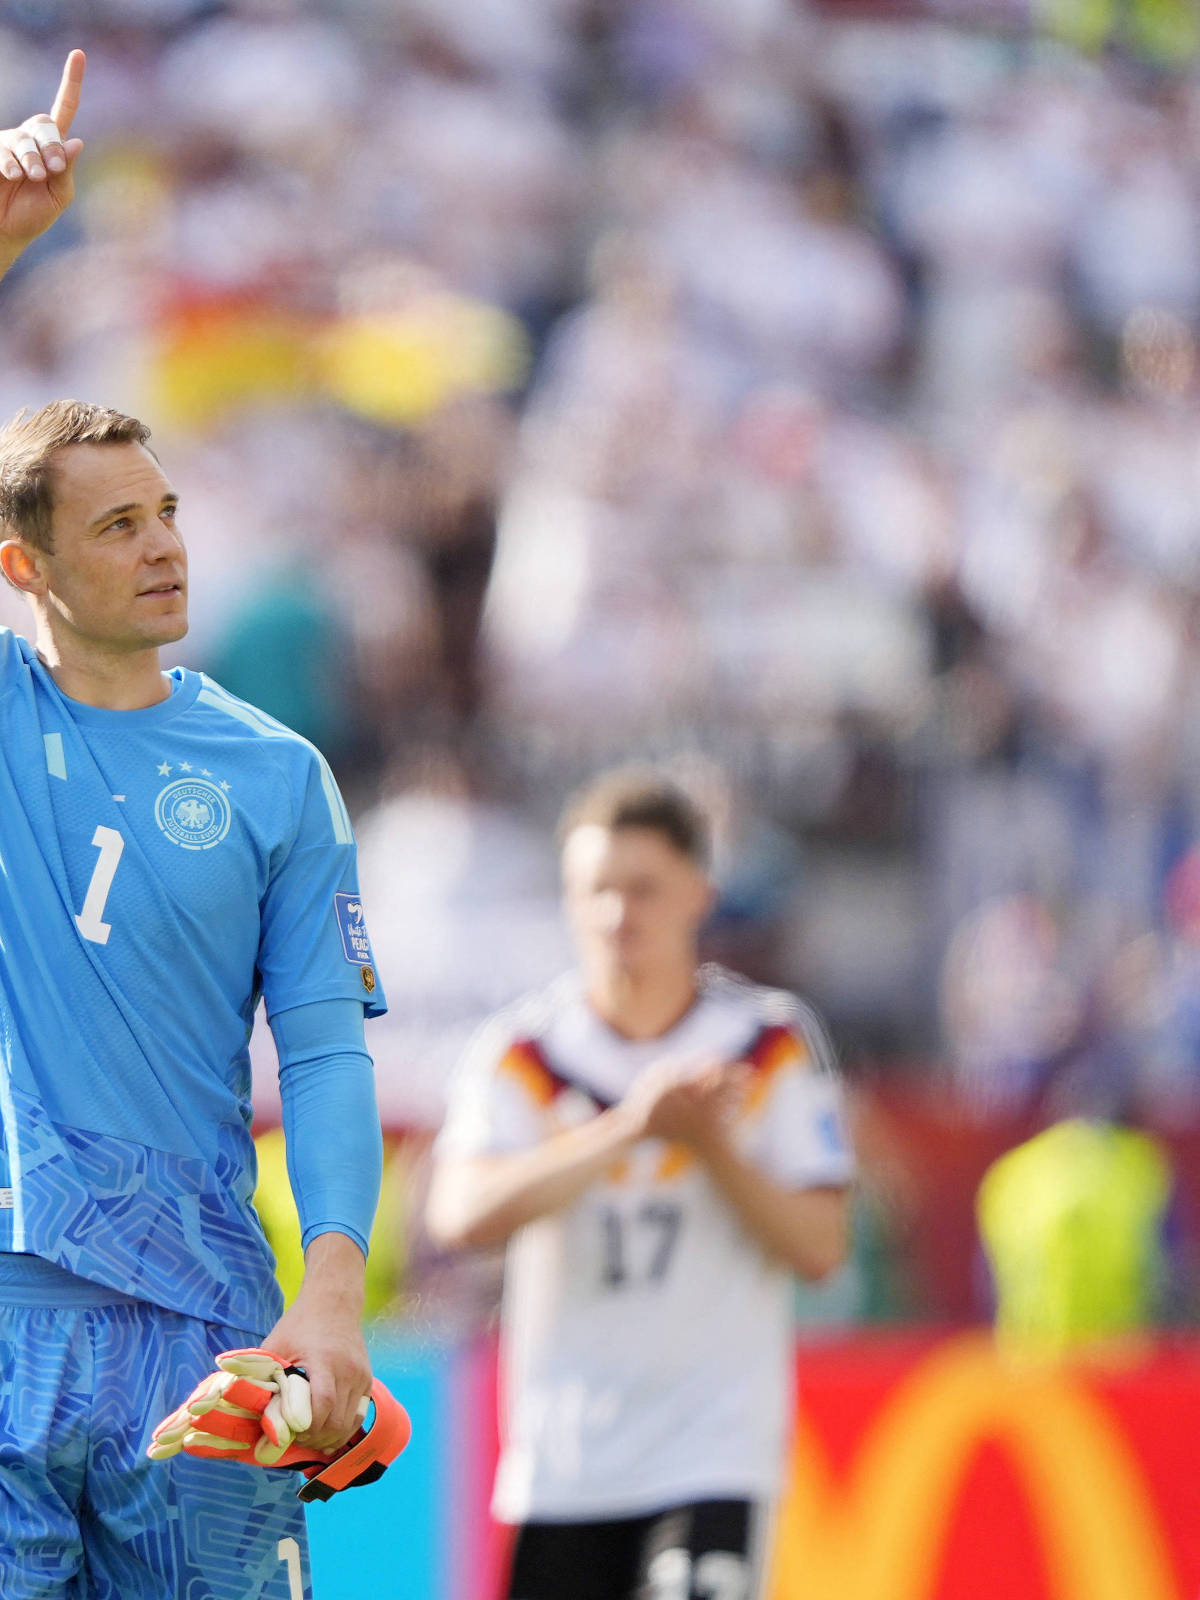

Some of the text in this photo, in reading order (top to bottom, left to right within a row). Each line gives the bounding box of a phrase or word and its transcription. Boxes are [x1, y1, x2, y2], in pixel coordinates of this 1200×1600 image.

[74, 825, 125, 945] 1
[601, 1203, 683, 1288] 17
[277, 1536, 304, 1600] 1
